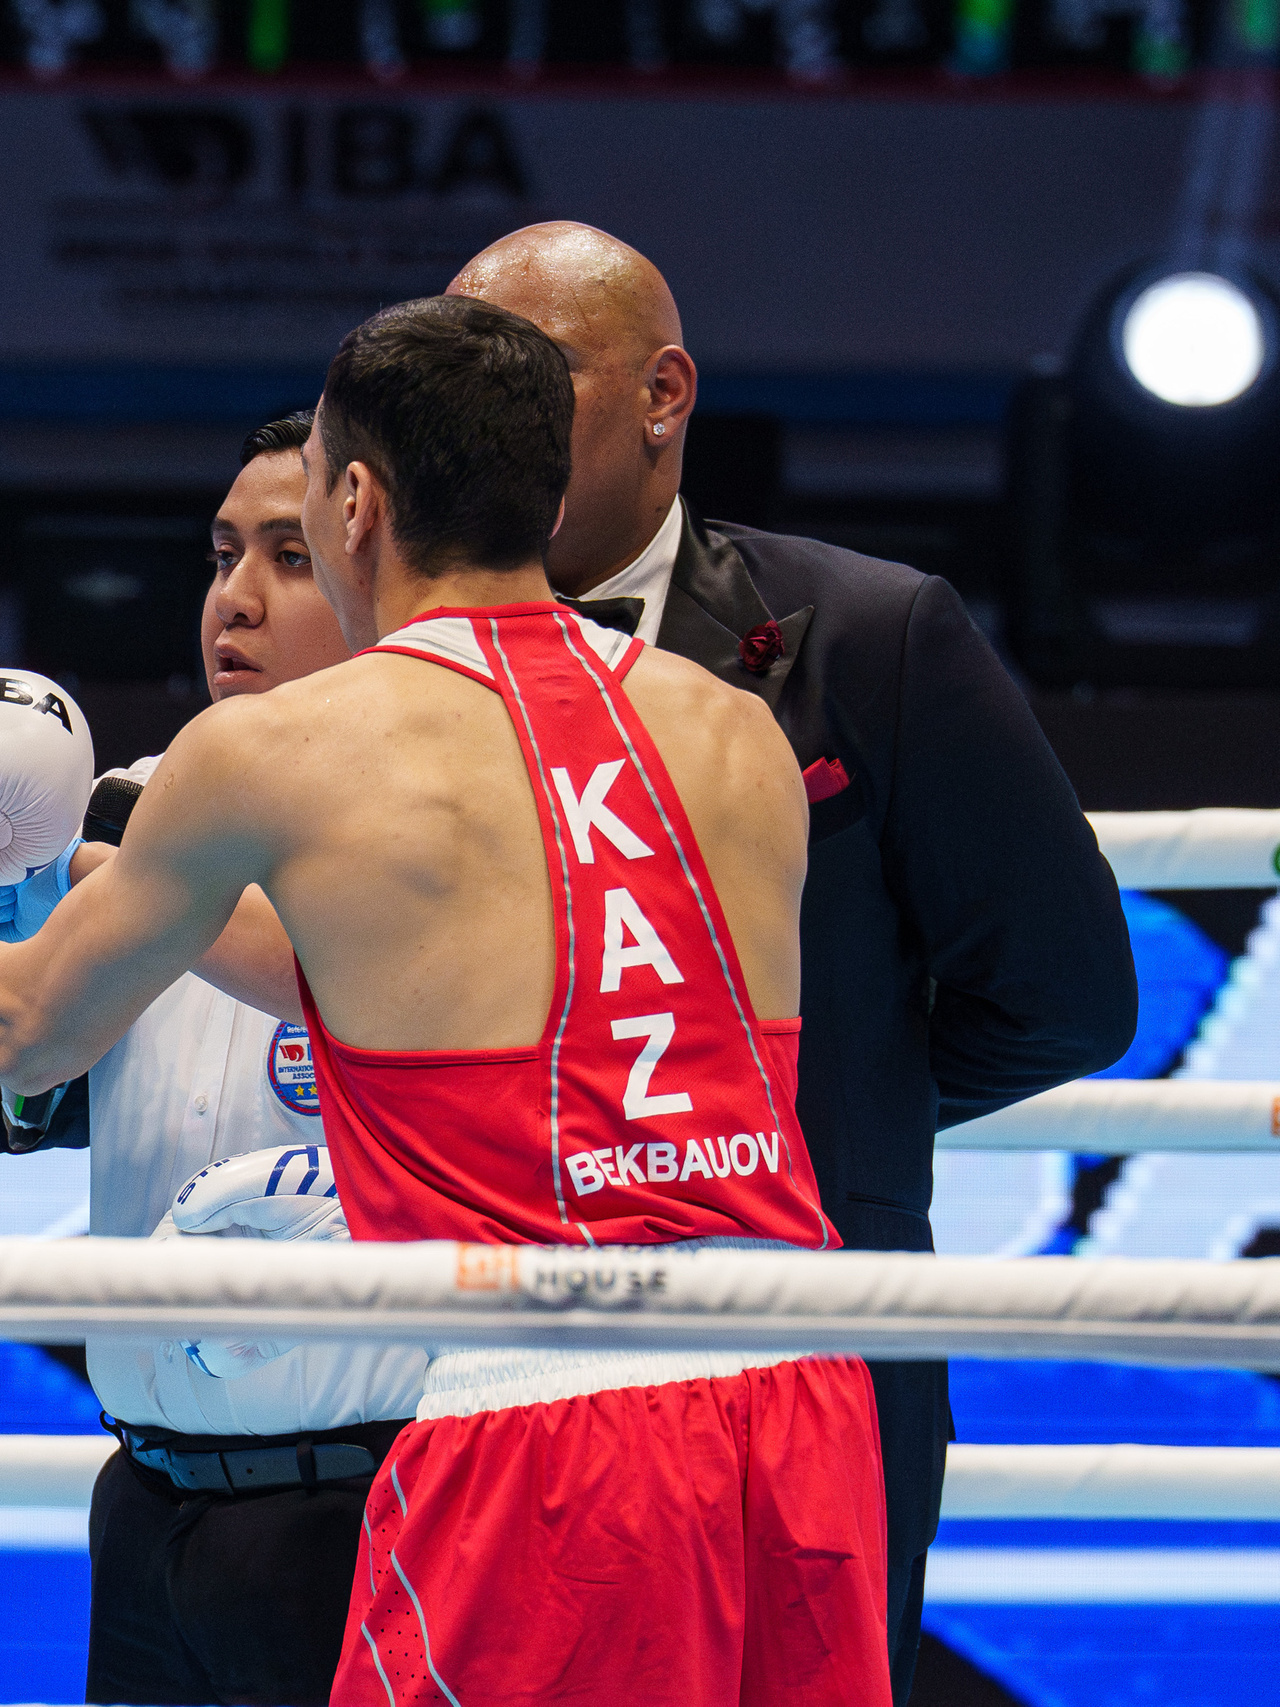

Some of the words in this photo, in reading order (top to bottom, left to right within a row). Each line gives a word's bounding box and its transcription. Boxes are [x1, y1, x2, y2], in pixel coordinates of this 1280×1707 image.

[281, 106, 528, 196] IBA
[550, 758, 694, 1121] KAZ
[565, 1131, 780, 1197] BEKBAUOV
[536, 1269, 667, 1293] HOUSE
